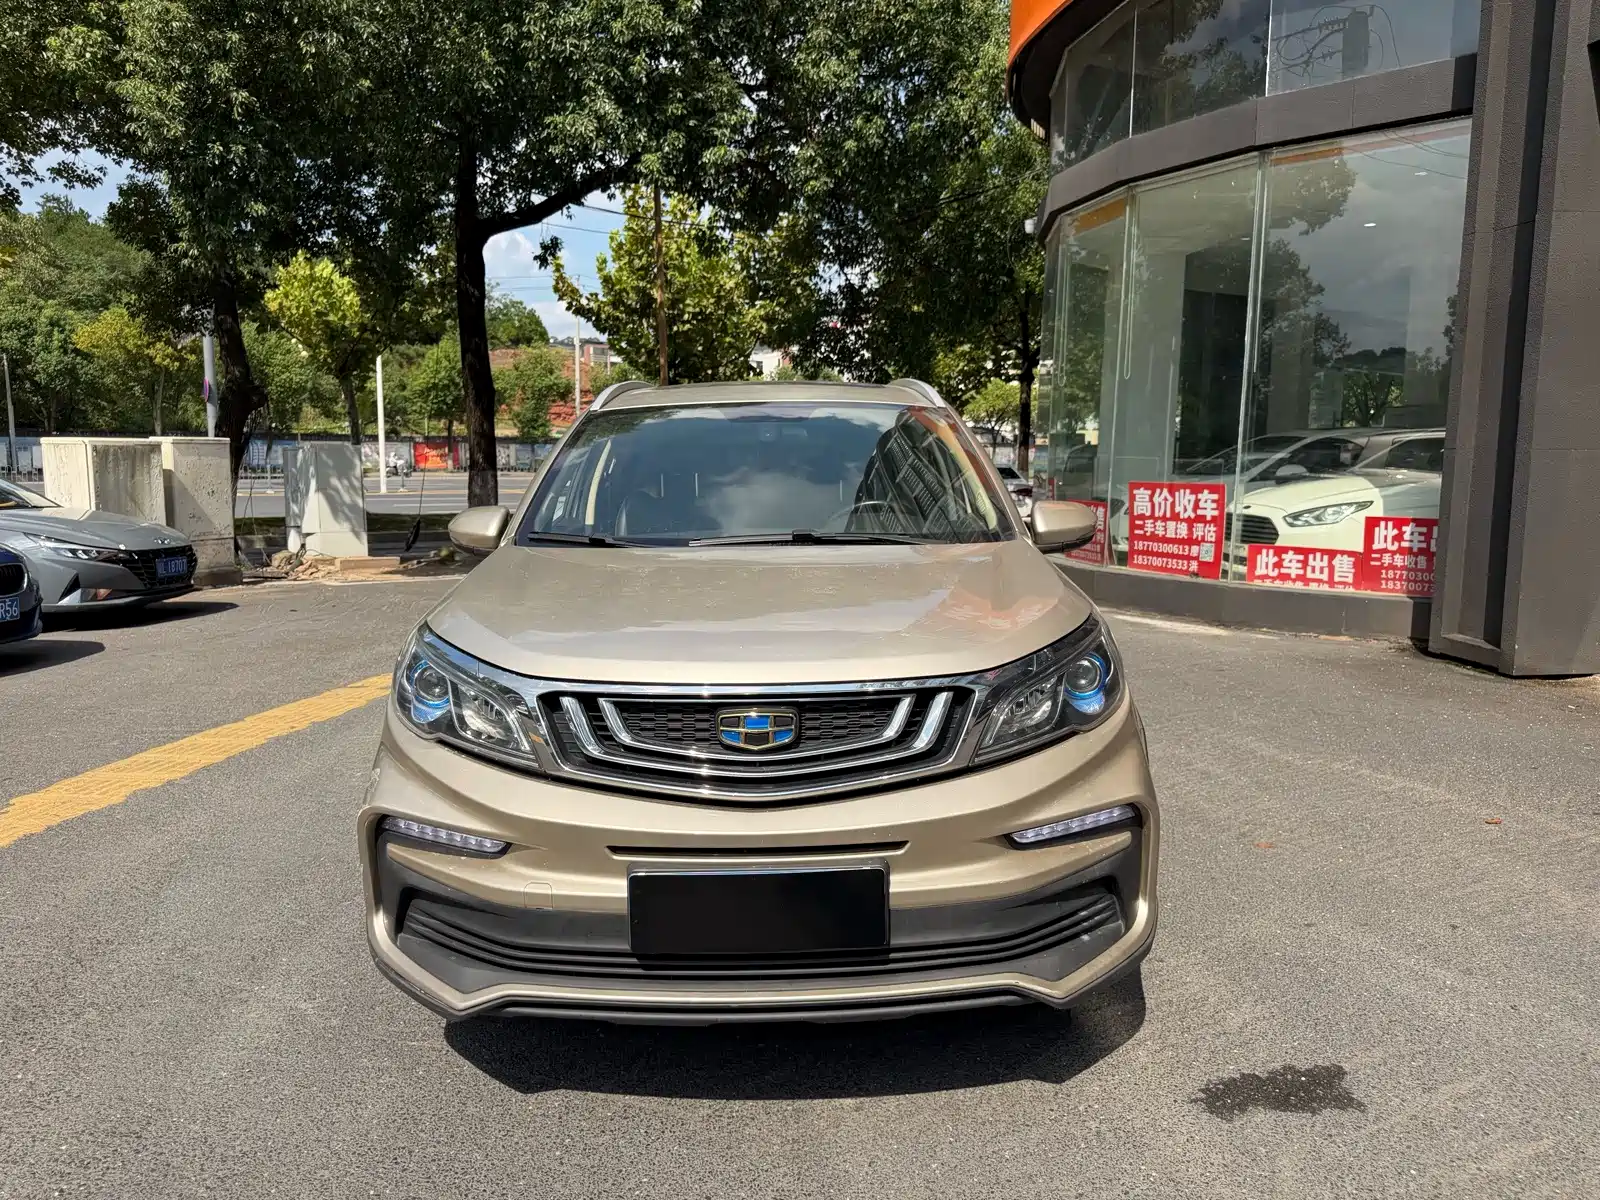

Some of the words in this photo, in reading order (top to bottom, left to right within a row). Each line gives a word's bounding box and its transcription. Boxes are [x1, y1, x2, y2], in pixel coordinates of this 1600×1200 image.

[1133, 487, 1219, 520] 高价收车
[1134, 520, 1188, 539] 二手车置换
[1193, 523, 1216, 542] 评估
[1134, 541, 1189, 555] 18770300613
[1133, 555, 1188, 570] 18370073533
[1255, 548, 1355, 583] 此车出售
[1370, 553, 1427, 569] 二手车收售
